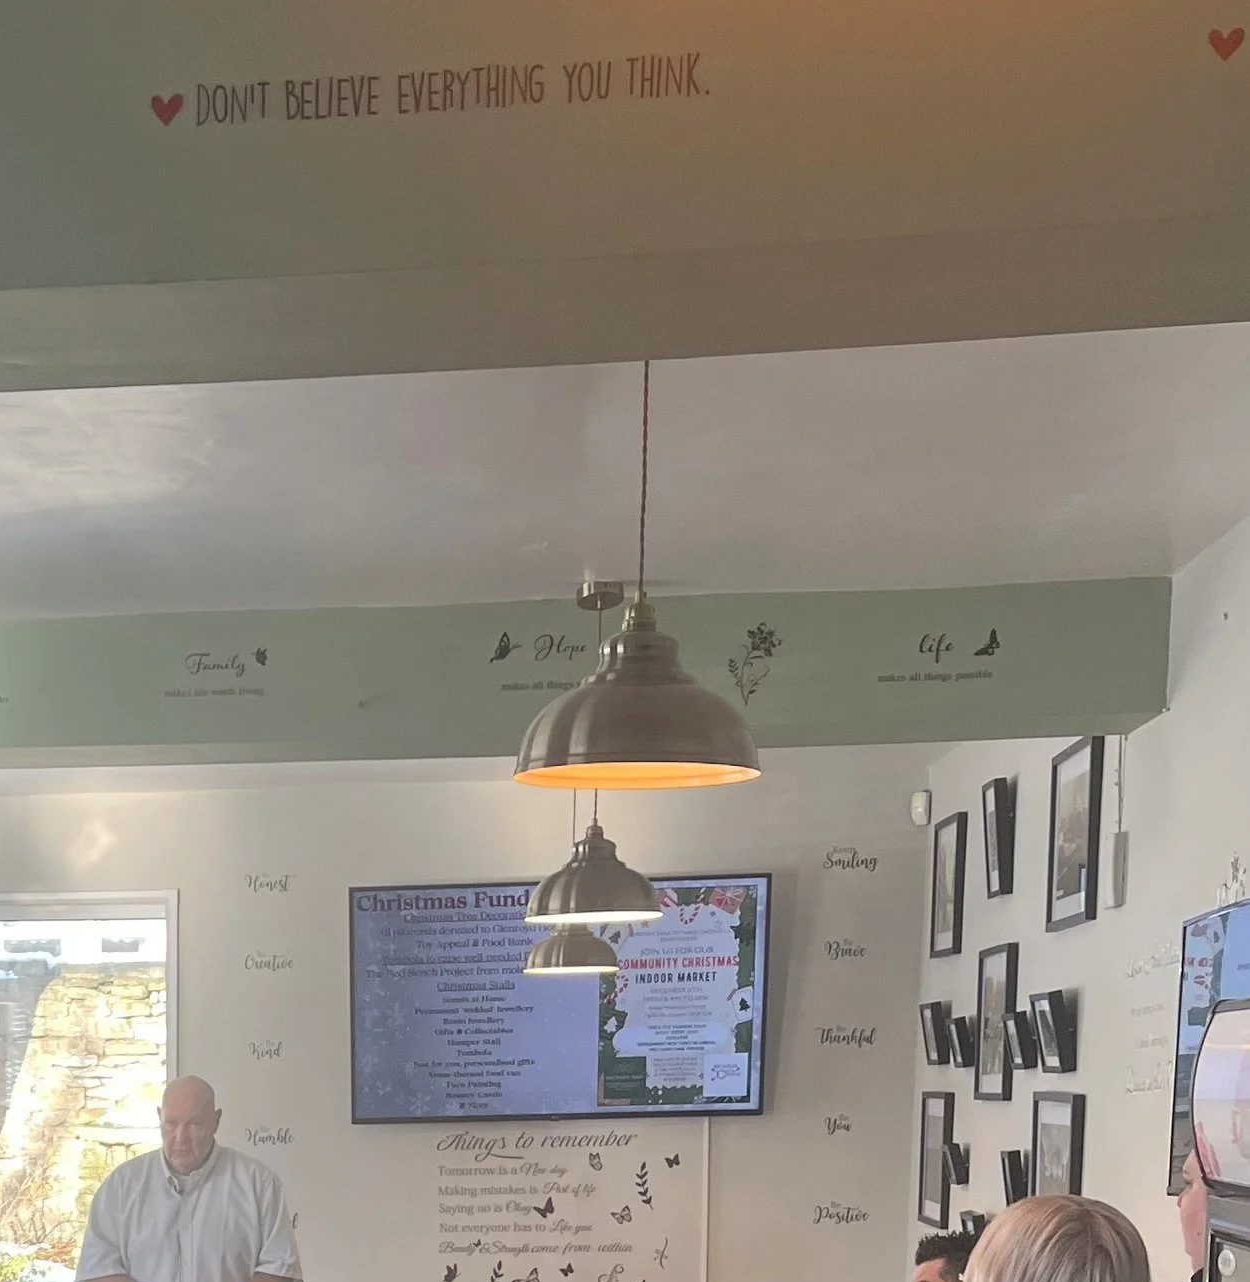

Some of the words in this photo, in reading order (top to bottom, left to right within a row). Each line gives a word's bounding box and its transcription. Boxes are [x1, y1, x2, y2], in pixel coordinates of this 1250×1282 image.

[197, 81, 270, 126] DON'T
[285, 75, 380, 120] BELIEVE
[398, 64, 545, 114] EVERYTHING
[562, 61, 611, 104] YOU
[626, 51, 710, 99] THINK.
[534, 634, 586, 661] Hope
[185, 653, 245, 677] Family
[878, 674, 906, 682] makes
[909, 672, 921, 681] all
[924, 672, 952, 683] things
[501, 682, 529, 690] makes
[532, 681, 543, 690] all
[547, 681, 574, 691] things
[823, 850, 878, 872] Smiling
[244, 874, 298, 893] Honest
[357, 892, 467, 912] Christmas
[403, 911, 452, 923] Christmas
[456, 911, 478, 922] Tree
[439, 924, 478, 935] donated
[481, 925, 491, 934] to
[417, 940, 432, 949] Toy
[437, 939, 469, 951] Appeal
[472, 939, 478, 947] &
[482, 938, 505, 947] Food
[508, 937, 533, 946] Bank
[825, 940, 866, 960] Brave
[245, 952, 294, 971] Creative
[618, 957, 679, 971] COMMUNITY
[682, 955, 739, 968] CHRISTMAS
[440, 966, 475, 979] Project
[477, 965, 499, 975] from
[635, 973, 673, 984] INDOOR
[678, 971, 718, 983] MARKET
[437, 981, 486, 992] Christmas
[489, 980, 515, 991] Stalls
[415, 1007, 459, 1015] Permanent
[250, 1040, 283, 1060] Kind
[483, 1038, 501, 1046] Stall
[431, 1060, 443, 1068] for
[467, 1081, 502, 1089] Painting
[824, 1116, 851, 1135] You
[245, 1127, 294, 1146] Humble
[437, 1131, 524, 1162] Things
[515, 1131, 534, 1149] to
[541, 1130, 638, 1149] remember
[438, 1165, 495, 1176] Tomorrow
[499, 1165, 508, 1175] is
[511, 1167, 518, 1175] a
[520, 1163, 547, 1176] New
[549, 1165, 567, 1178] day
[438, 1185, 477, 1198] Making
[481, 1184, 526, 1195] mistakes
[530, 1184, 538, 1194] is
[542, 1182, 568, 1195] Part
[571, 1183, 582, 1197] of
[582, 1183, 596, 1197] life
[439, 1203, 474, 1215] Saying
[478, 1205, 491, 1213] no
[494, 1203, 502, 1212] is
[505, 1200, 533, 1215] Okay
[813, 1205, 870, 1224] Positive
[439, 1222, 458, 1233] Not
[461, 1223, 510, 1235] everyone
[513, 1221, 532, 1232] has
[535, 1222, 546, 1231] to
[550, 1219, 571, 1235] Like
[574, 1224, 592, 1235] you
[438, 1241, 475, 1256] Beauty
[531, 1245, 559, 1254] come
[563, 1243, 590, 1255] from
[598, 1242, 633, 1253] within
